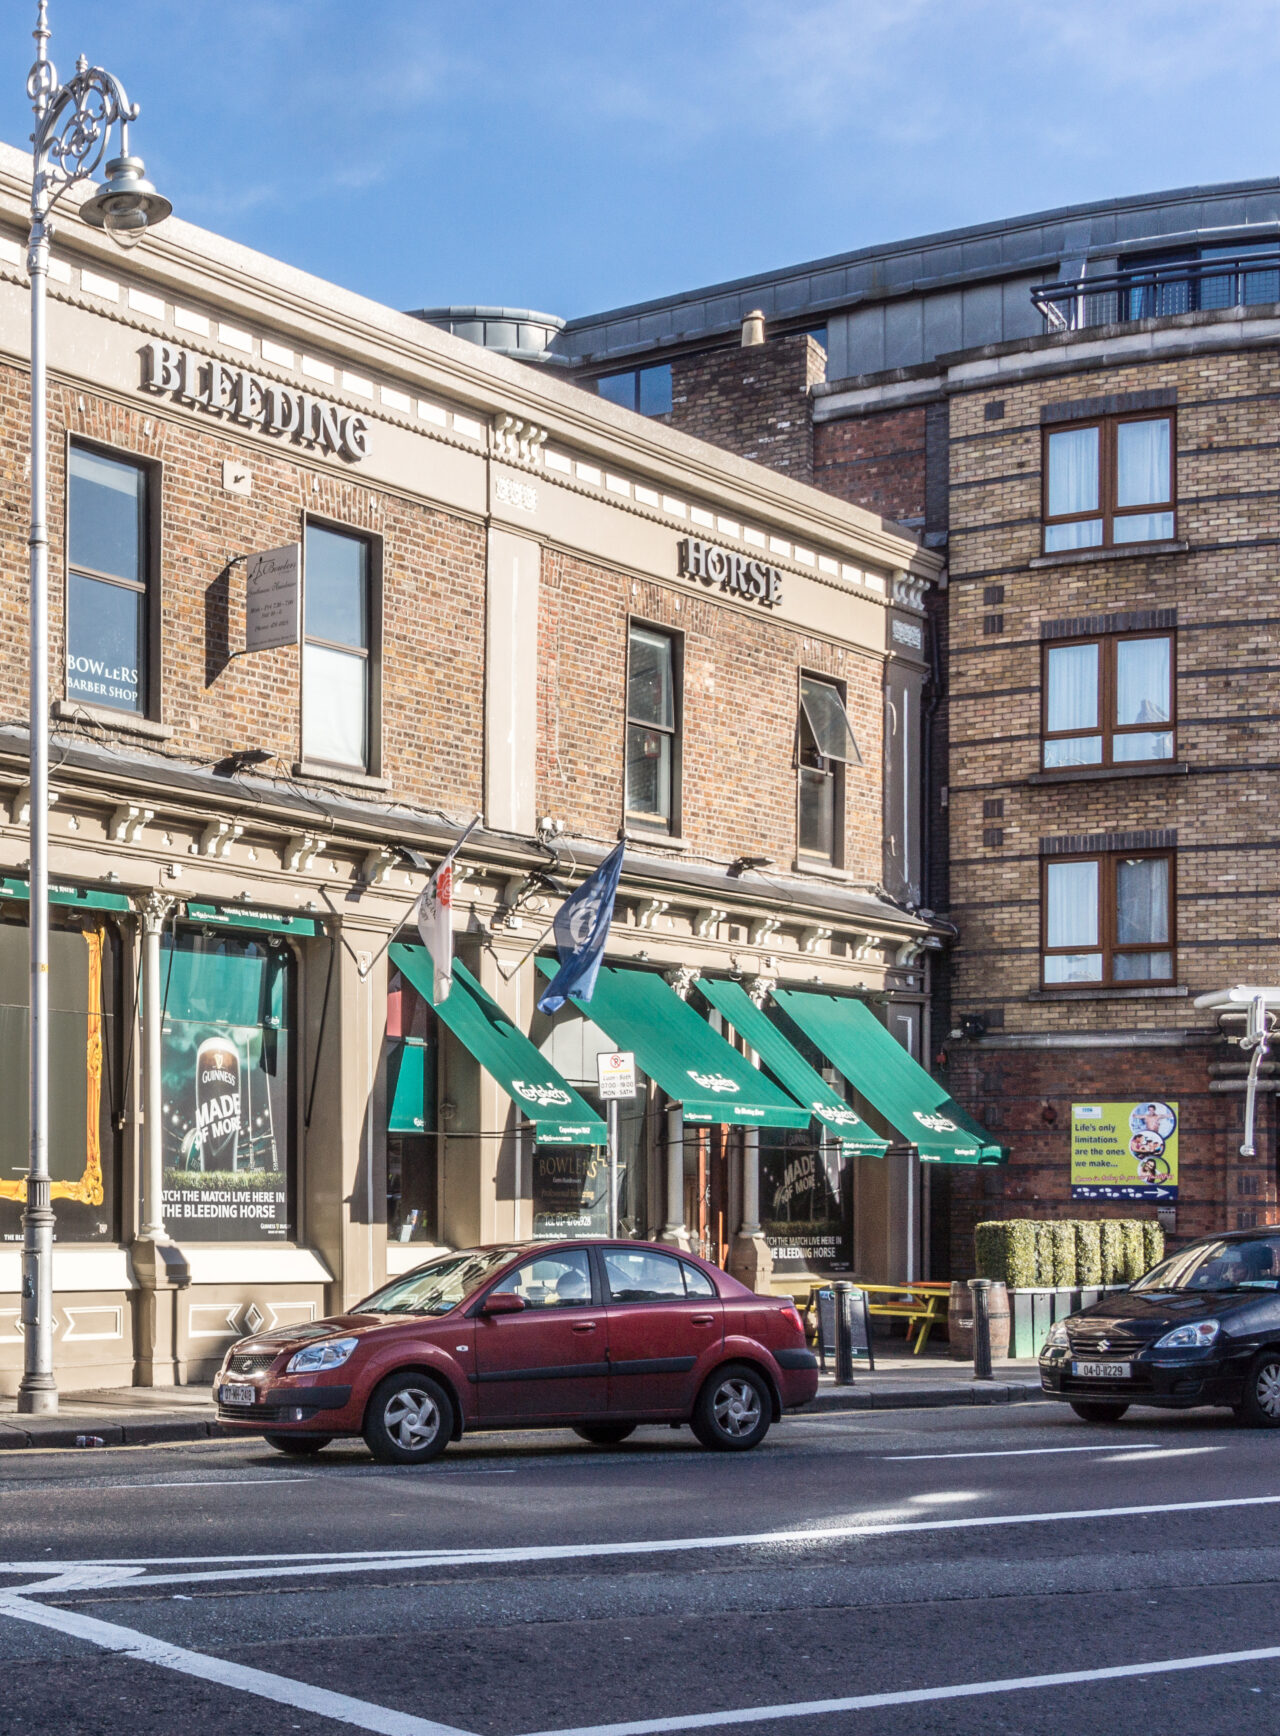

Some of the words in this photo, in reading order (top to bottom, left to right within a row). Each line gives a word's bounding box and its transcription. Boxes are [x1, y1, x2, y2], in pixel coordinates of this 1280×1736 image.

[149, 341, 372, 458] BLEEDING
[686, 537, 783, 606] HORSE
[68, 677, 107, 695] BARBER
[109, 686, 138, 702] SHOP
[202, 1070, 236, 1086] GUINNESS
[512, 1080, 572, 1106] Carlsberg
[195, 1092, 241, 1127] MADE
[195, 1126, 209, 1150] OF
[211, 1115, 241, 1139] MORE
[1075, 1123, 1096, 1132] Life's
[1098, 1124, 1116, 1134] only
[784, 1154, 816, 1187] MADE
[1089, 1160, 1118, 1168] make...
[795, 1174, 816, 1195] MORE
[160, 1190, 180, 1201] ATCH
[182, 1190, 199, 1201] THE
[201, 1190, 231, 1202] MATCH
[232, 1191, 251, 1202] LIVE
[252, 1191, 274, 1203] HERE
[275, 1192, 285, 1203] IN
[161, 1204, 181, 1218] THE
[184, 1204, 237, 1218] BLEEDING
[240, 1205, 275, 1218] HORSE
[766, 1237, 776, 1245] TCH
[778, 1237, 788, 1245] THE
[790, 1236, 807, 1245] MATCH
[809, 1237, 820, 1245] LIVE
[821, 1236, 835, 1245] HERE
[836, 1236, 842, 1244] IN
[770, 1249, 778, 1259] HE
[779, 1248, 812, 1259] BLEEDING
[814, 1247, 836, 1258] HORSE
